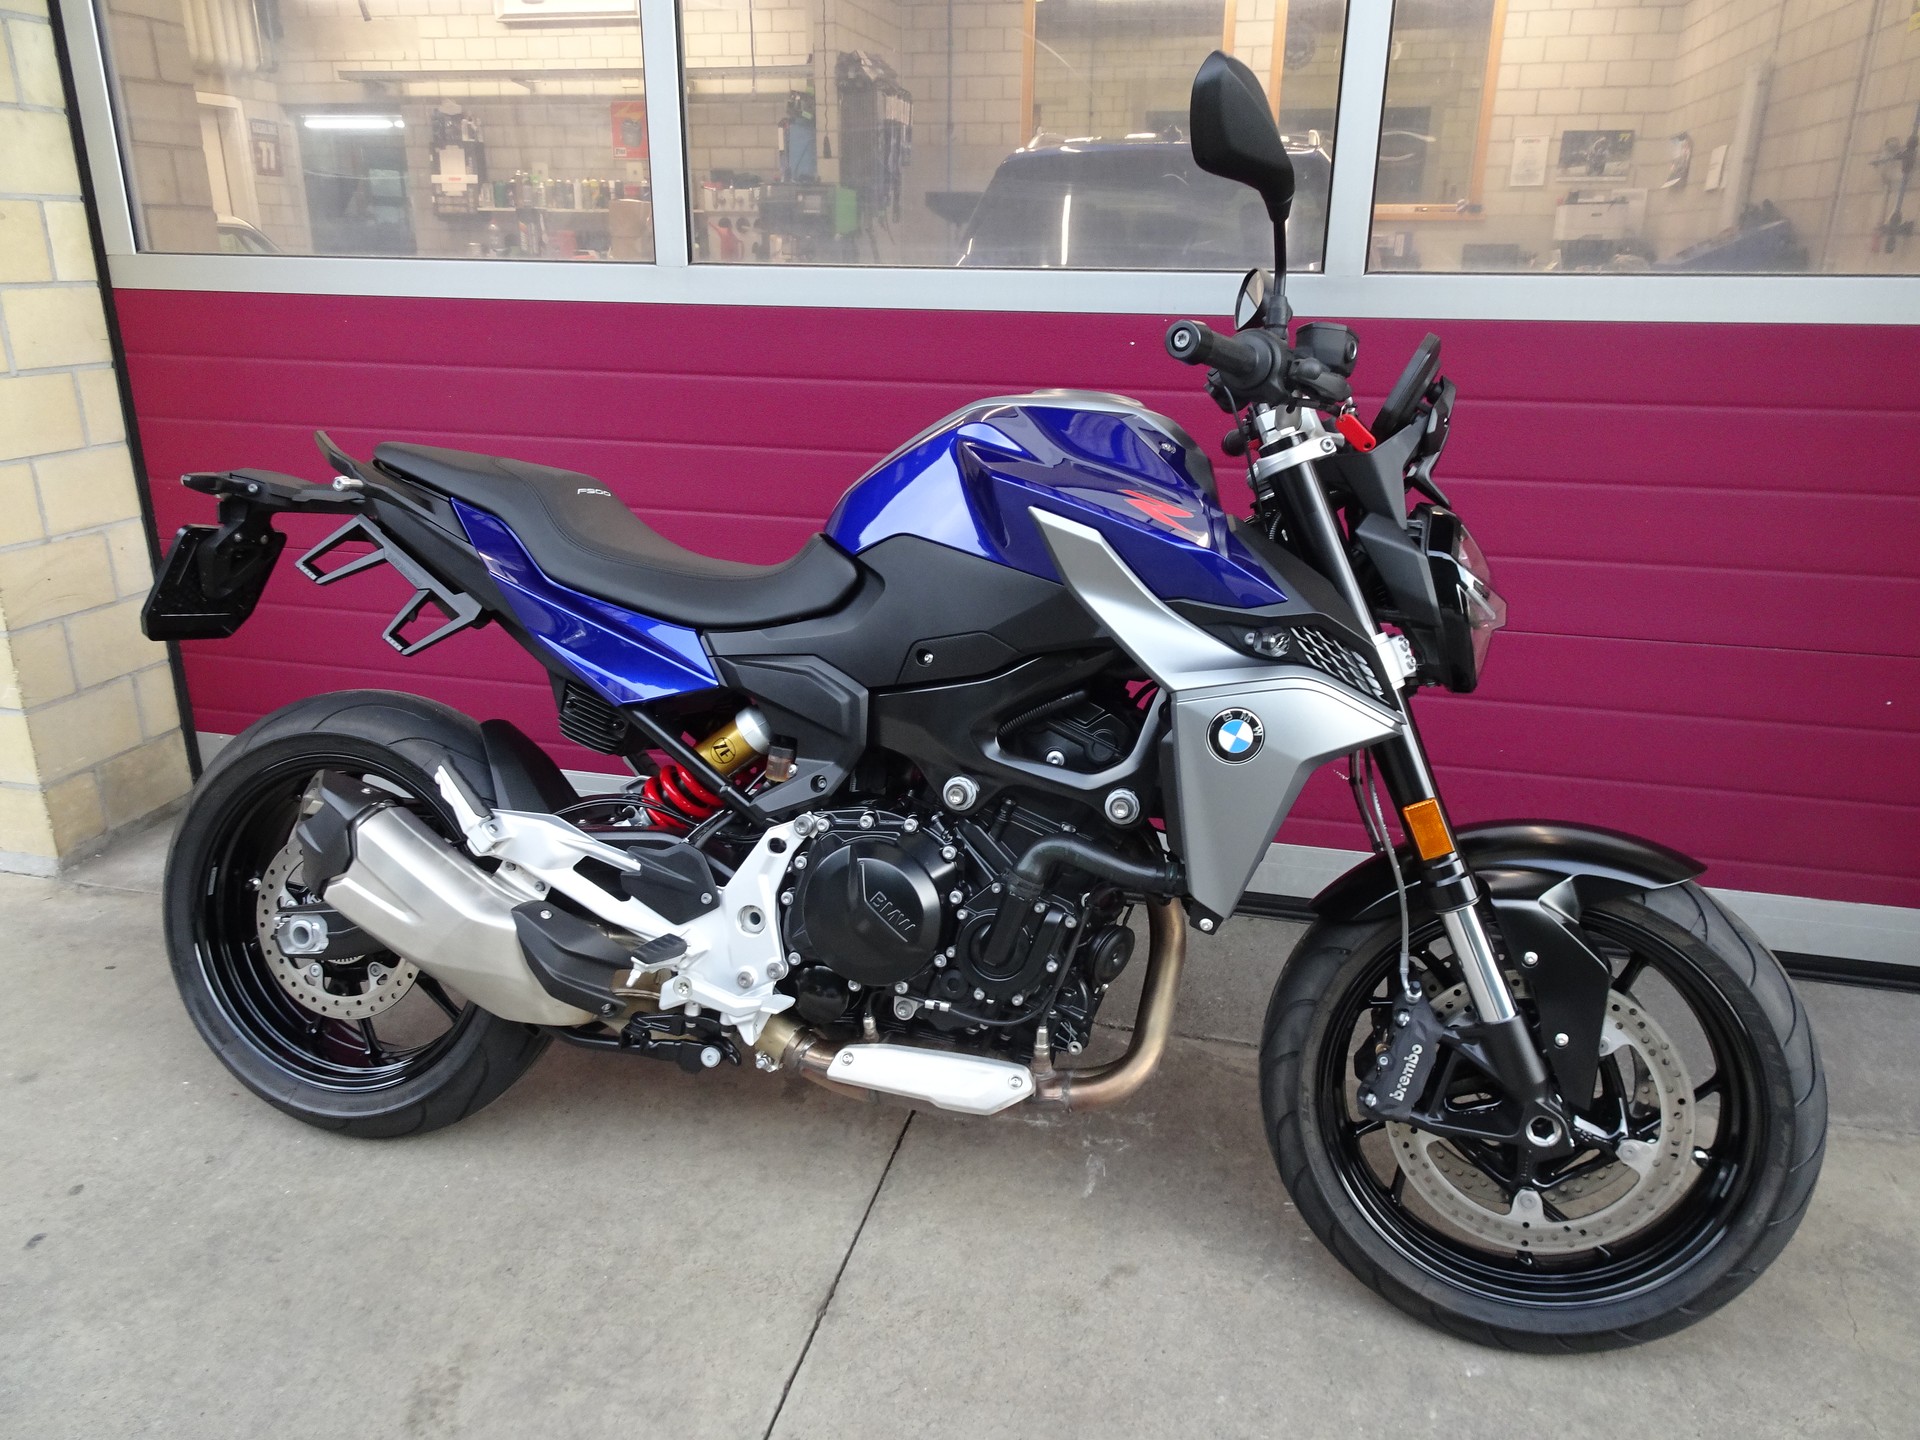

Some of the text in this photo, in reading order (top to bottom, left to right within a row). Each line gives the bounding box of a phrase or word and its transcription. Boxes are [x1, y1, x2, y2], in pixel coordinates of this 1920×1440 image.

[1222, 709, 1264, 736] BMW
[870, 891, 916, 931] BMW
[1389, 1043, 1423, 1102] brembo
